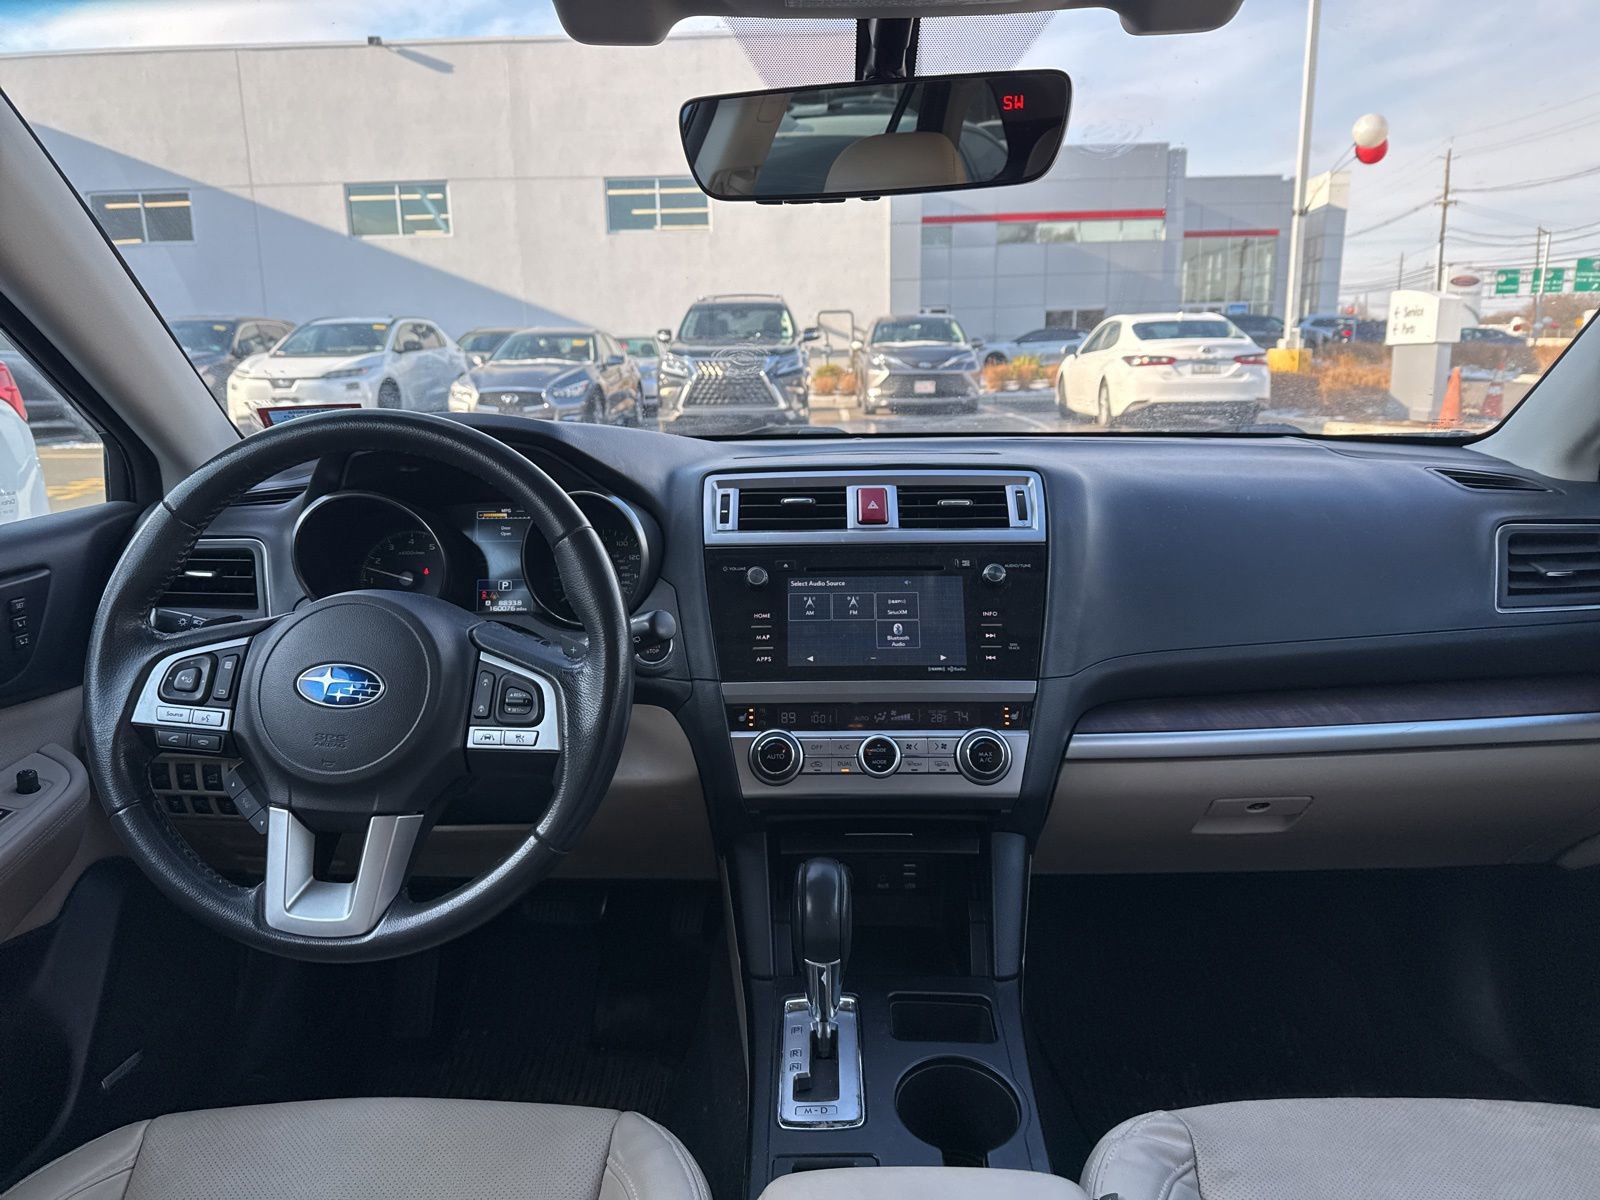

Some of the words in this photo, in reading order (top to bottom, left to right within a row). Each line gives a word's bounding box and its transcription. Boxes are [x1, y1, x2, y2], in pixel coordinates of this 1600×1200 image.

[1003, 95, 1024, 110] SW
[501, 582, 509, 590] P
[166, 710, 184, 718] Source
[780, 712, 796, 723] 89
[954, 711, 969, 722] 74
[314, 732, 348, 742] SRS
